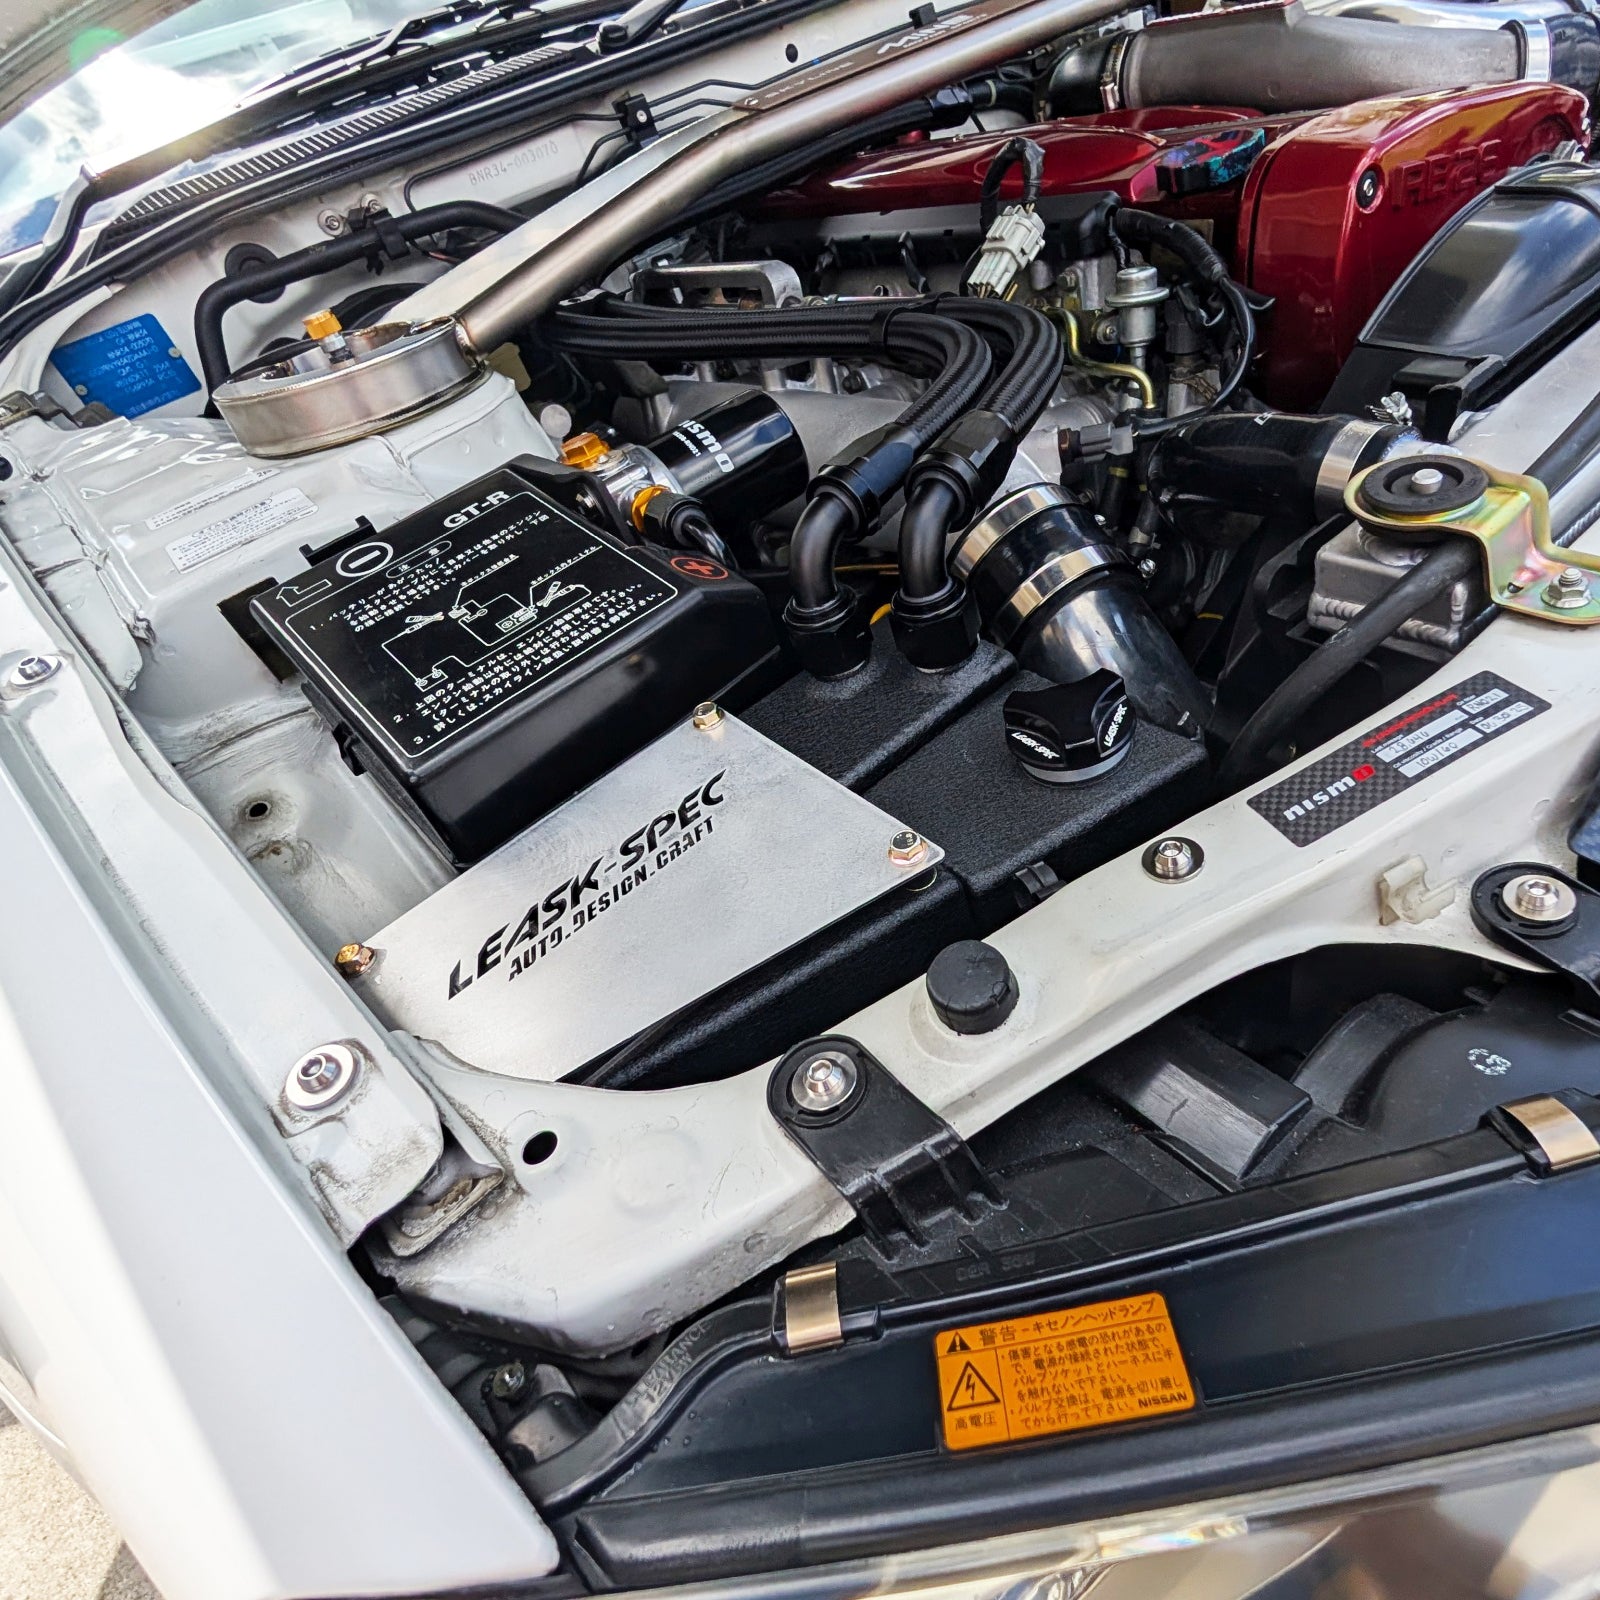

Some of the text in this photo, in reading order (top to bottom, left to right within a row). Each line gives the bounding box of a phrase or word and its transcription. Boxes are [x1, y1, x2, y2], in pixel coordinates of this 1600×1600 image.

[443, 489, 511, 528] GT-R
[1103, 704, 1128, 747] LEASK-SPEC
[1010, 732, 1061, 760] LEASK-SPEC
[1283, 764, 1376, 821] nismo
[448, 769, 727, 1000] LEASK-SPEC
[1136, 1389, 1188, 1409] NISSAN
[953, 1409, 997, 1432] 高電圧
